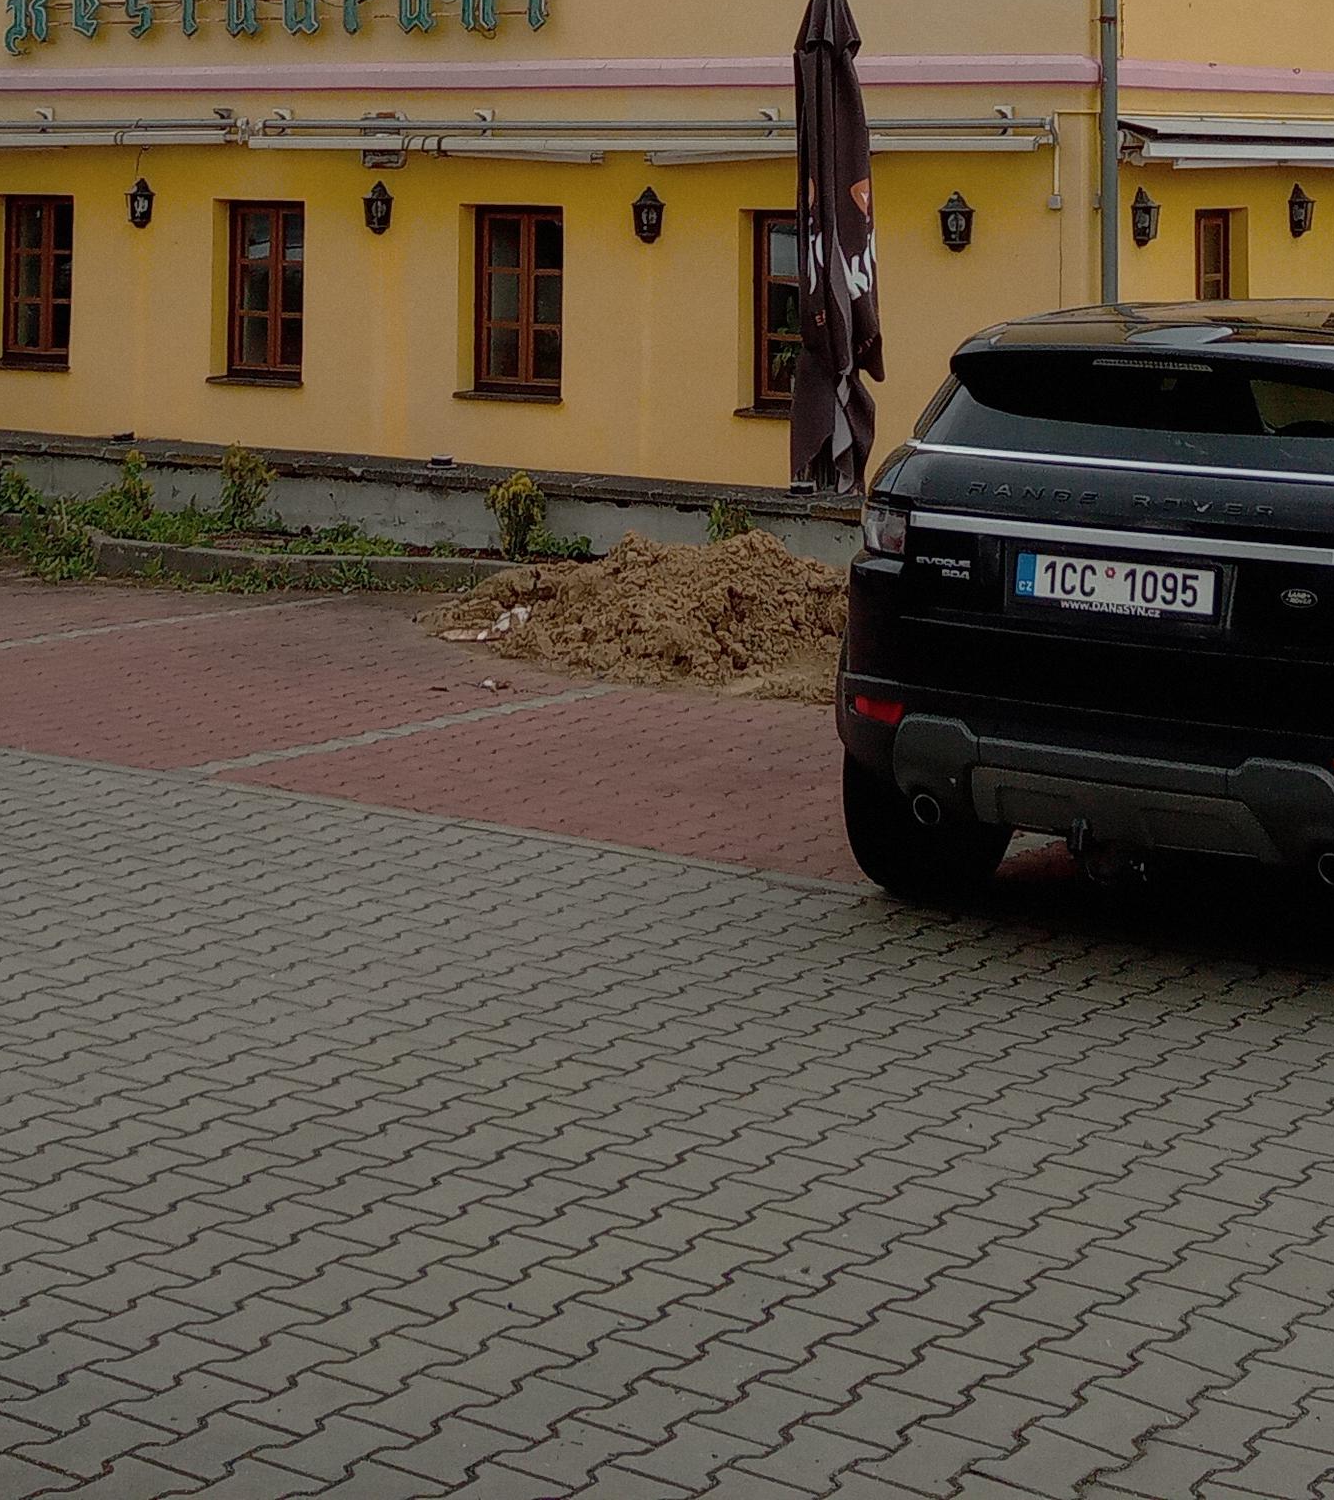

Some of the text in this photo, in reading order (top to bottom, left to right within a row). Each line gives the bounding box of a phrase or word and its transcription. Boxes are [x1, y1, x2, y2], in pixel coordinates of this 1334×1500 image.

[967, 481, 1100, 505] RANGE
[916, 556, 971, 568] EVOQUE
[1018, 580, 1033, 592] CZ
[1043, 560, 1200, 608] 1CC 1095
